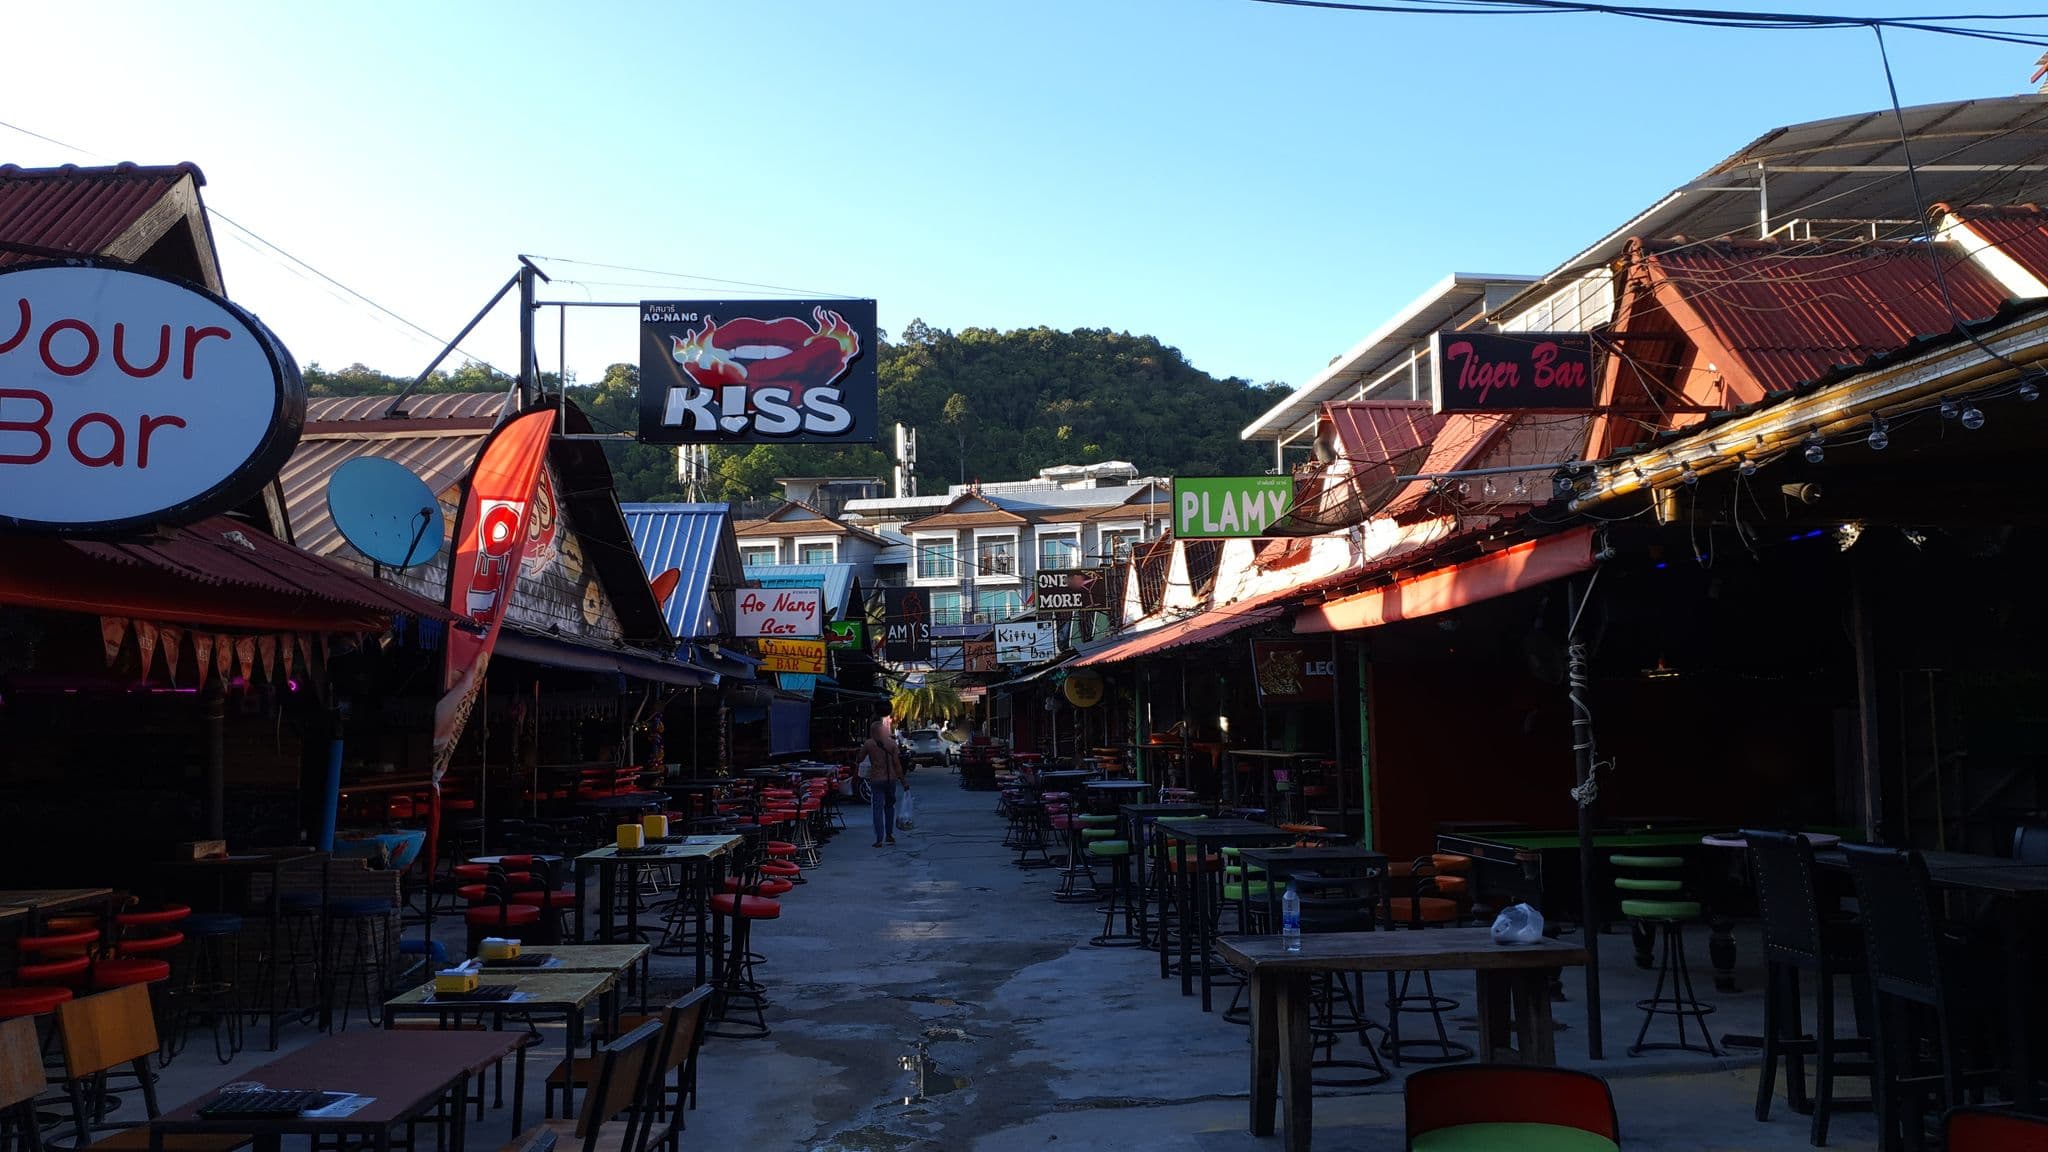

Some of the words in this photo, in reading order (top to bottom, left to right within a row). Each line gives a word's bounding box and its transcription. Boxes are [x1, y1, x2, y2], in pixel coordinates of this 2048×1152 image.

[643, 312, 698, 322] AO-NANG
[1447, 341, 1520, 404] Tiger
[1531, 341, 1586, 388] Bar
[0, 388, 187, 469] Bar
[1182, 490, 1287, 533] PLAMY
[1039, 574, 1069, 588] ONE
[740, 593, 767, 615] Ao
[772, 592, 817, 621] Nang
[1040, 593, 1083, 608] MORE
[760, 618, 797, 634] Bar
[887, 621, 929, 652] AMY'S
[998, 628, 1036, 645] Kitty
[776, 657, 800, 671] BAR
[782, 645, 813, 657] NANG
[812, 647, 823, 672] 2
